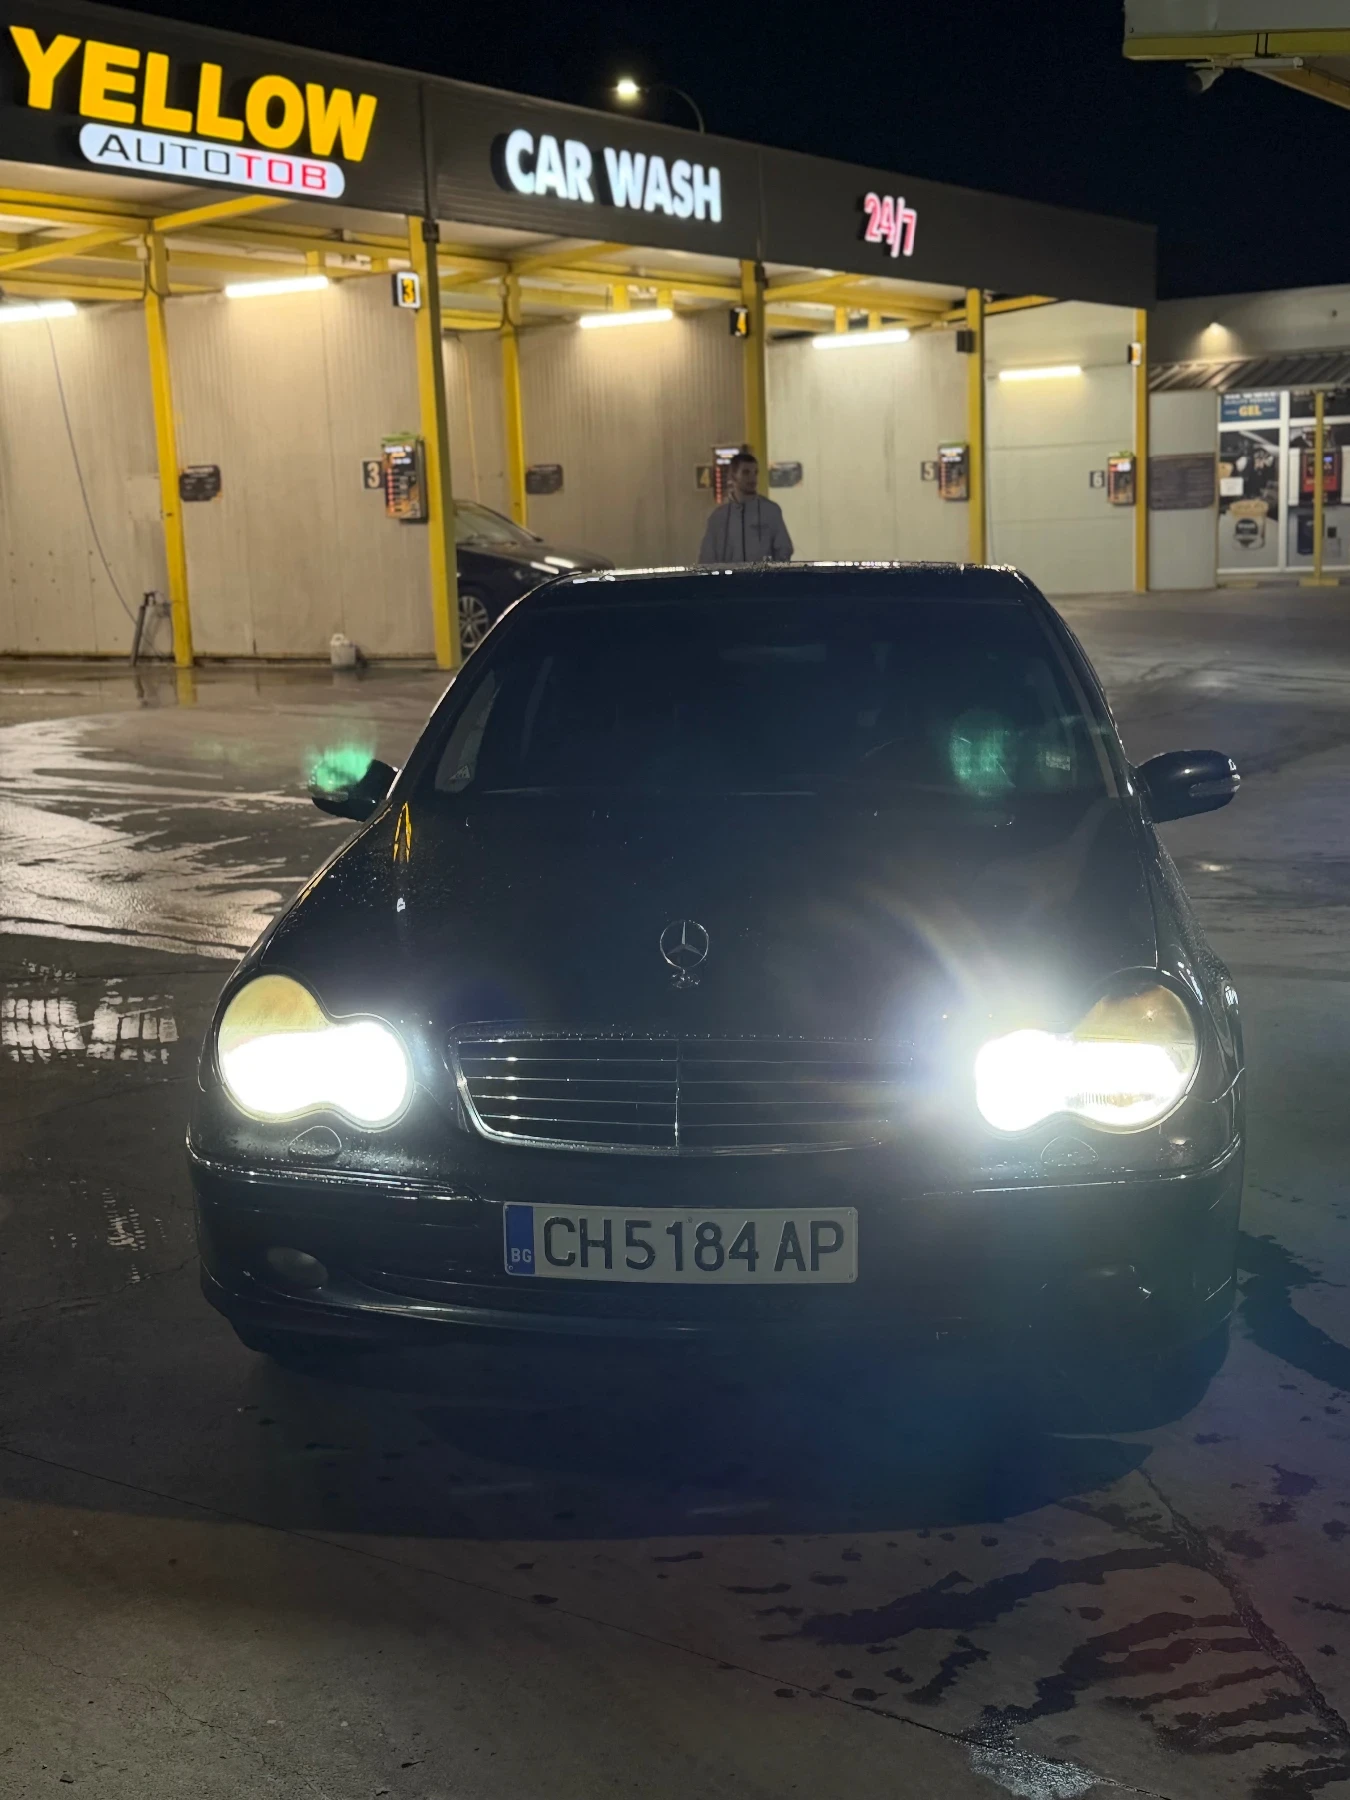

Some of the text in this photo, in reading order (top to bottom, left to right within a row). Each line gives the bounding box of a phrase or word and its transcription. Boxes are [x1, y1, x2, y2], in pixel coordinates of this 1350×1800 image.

[10, 26, 377, 162] YELLOW
[97, 133, 327, 191] AUTOTOB
[505, 129, 722, 223] CAR WASH
[864, 191, 917, 259] 24/7
[402, 278, 415, 304] 3
[367, 462, 380, 488] 3
[511, 1248, 532, 1264] BG
